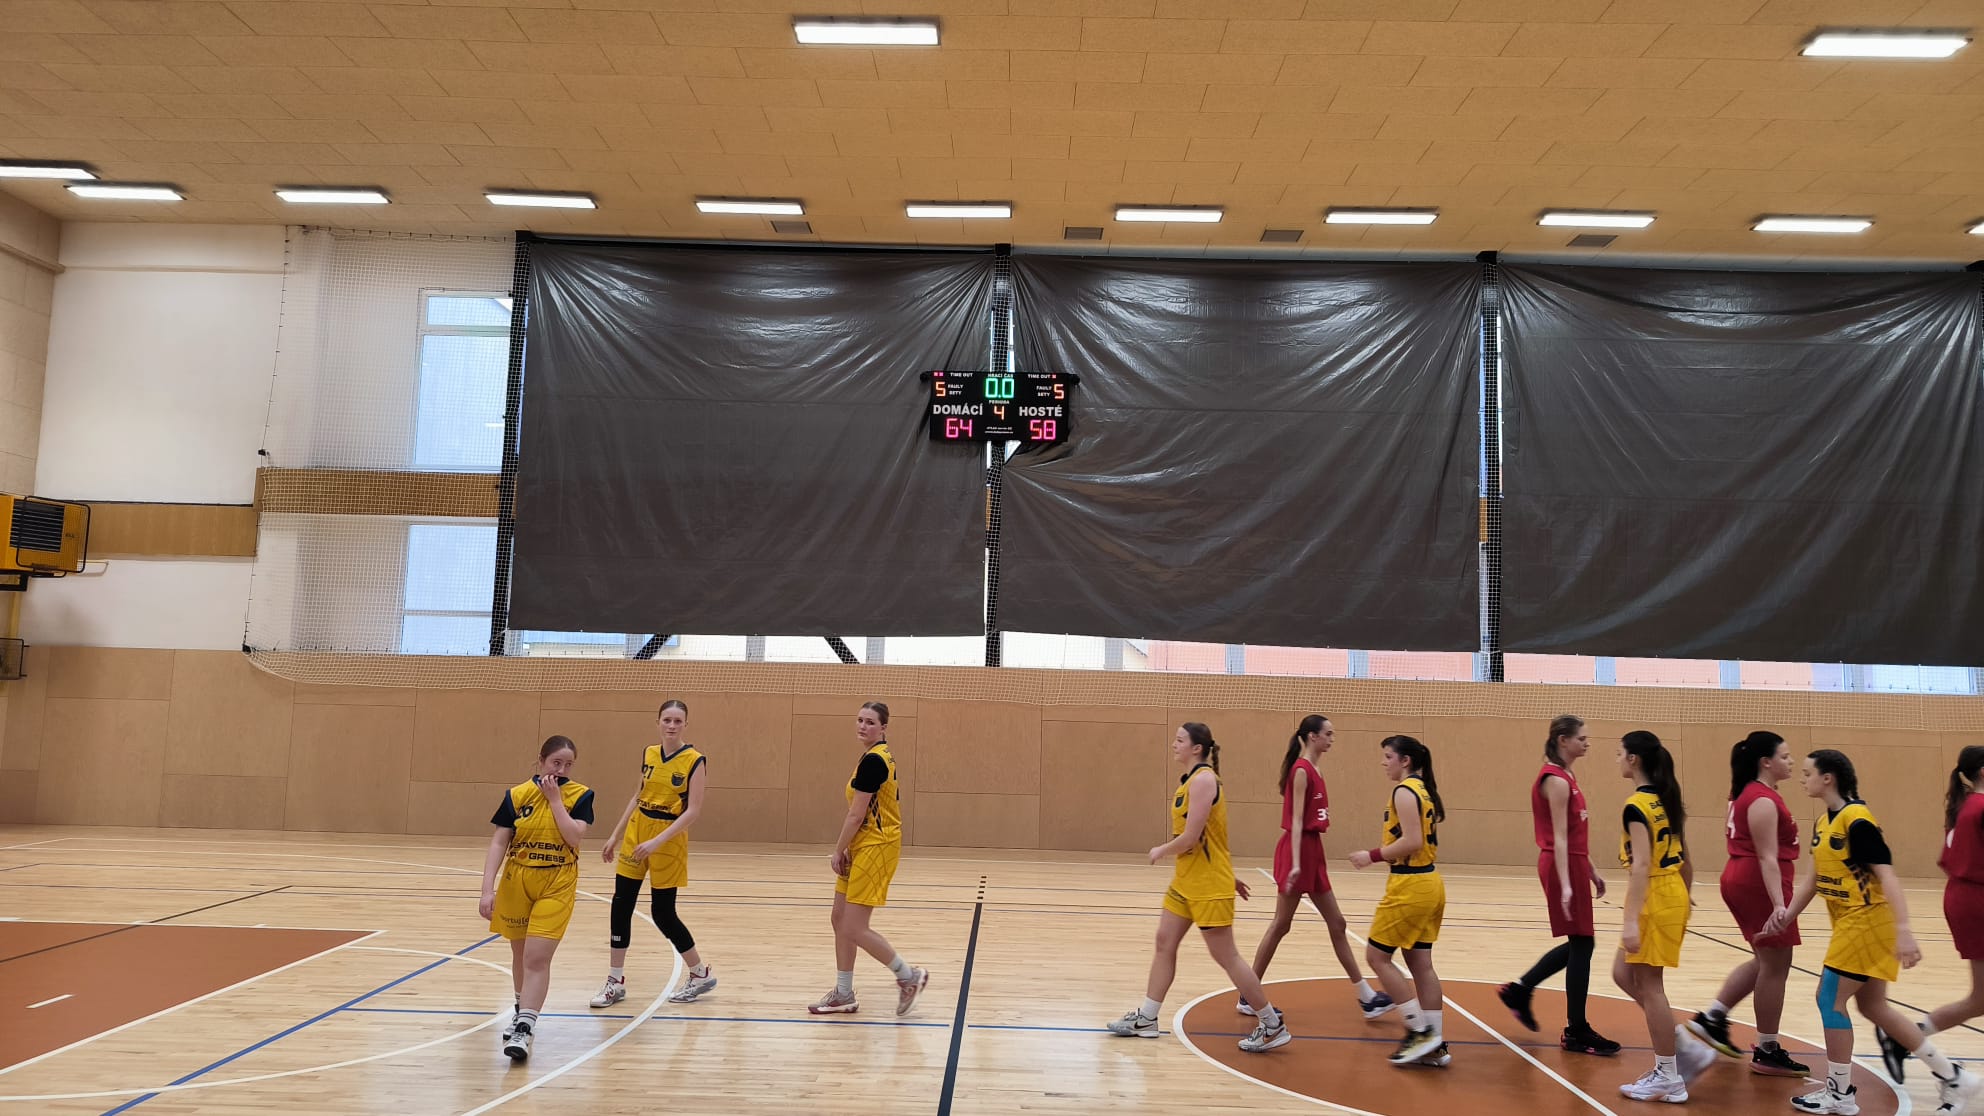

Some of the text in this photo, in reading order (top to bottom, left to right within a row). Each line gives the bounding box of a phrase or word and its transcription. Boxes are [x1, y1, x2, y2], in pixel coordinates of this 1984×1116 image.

[935, 381, 946, 397] 5
[985, 377, 1015, 399] 0.0
[1053, 383, 1065, 399] 5
[932, 402, 984, 416] DOMÁCÍ
[993, 404, 1005, 420] 4
[1018, 404, 1063, 417] HOSTÉ
[945, 417, 973, 438] 64
[1029, 419, 1057, 440] 58
